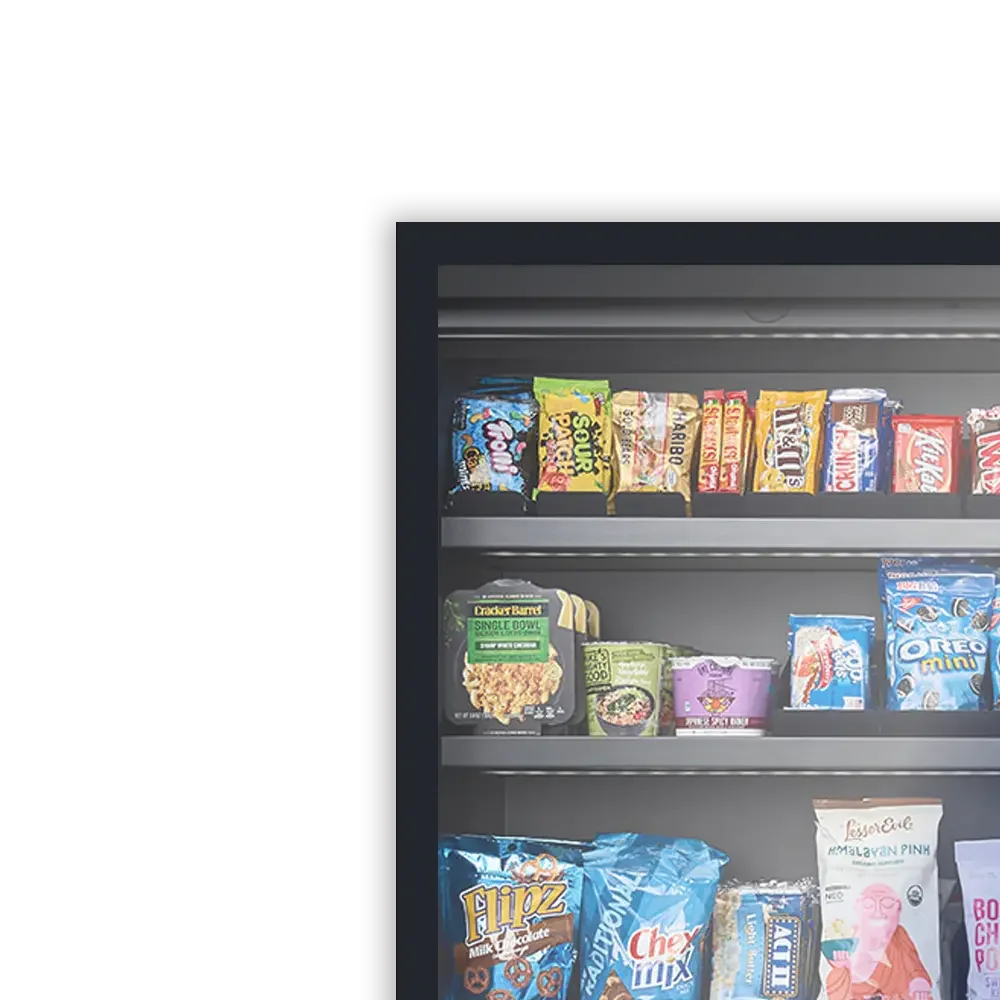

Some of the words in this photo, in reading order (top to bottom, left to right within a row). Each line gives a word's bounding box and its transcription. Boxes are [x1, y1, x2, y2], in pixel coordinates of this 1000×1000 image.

[553, 412, 576, 477] PATCH
[571, 413, 593, 475] SOUR
[668, 409, 687, 468] HARIBO
[474, 604, 511, 616] Cracker
[511, 604, 542, 616] Barrel
[474, 619, 508, 631] SINGLE
[899, 637, 988, 662] OREO
[919, 654, 978, 673] mini
[900, 843, 931, 856] PINK
[460, 882, 568, 946] Flipz
[744, 912, 759, 945] Light
[628, 923, 703, 962] Chex
[773, 923, 793, 966] ACT
[631, 948, 693, 990] mix
